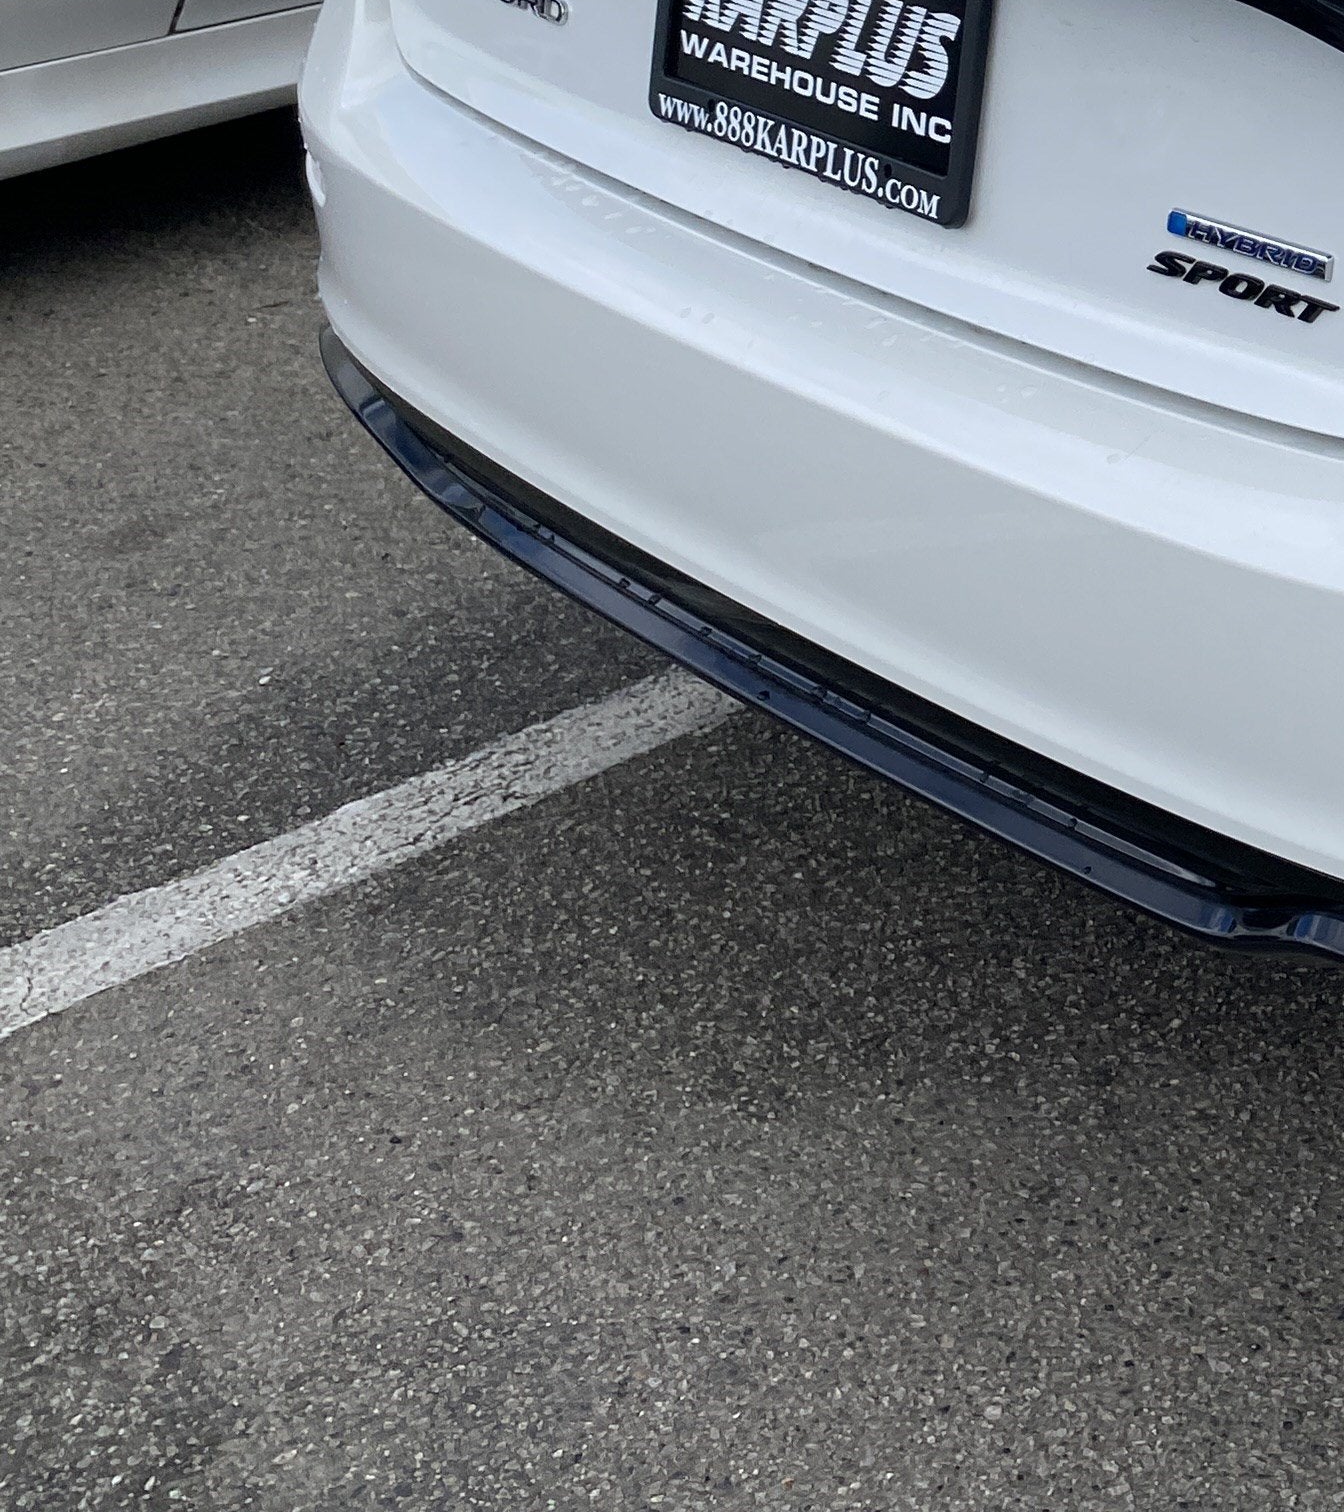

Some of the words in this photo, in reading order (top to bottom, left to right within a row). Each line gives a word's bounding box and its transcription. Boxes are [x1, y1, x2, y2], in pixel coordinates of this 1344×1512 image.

[680, 30, 880, 120] WAREHOUSE
[891, 102, 952, 143] INC
[1187, 220, 1319, 275] HYBRID
[1146, 250, 1340, 323] SPORT
